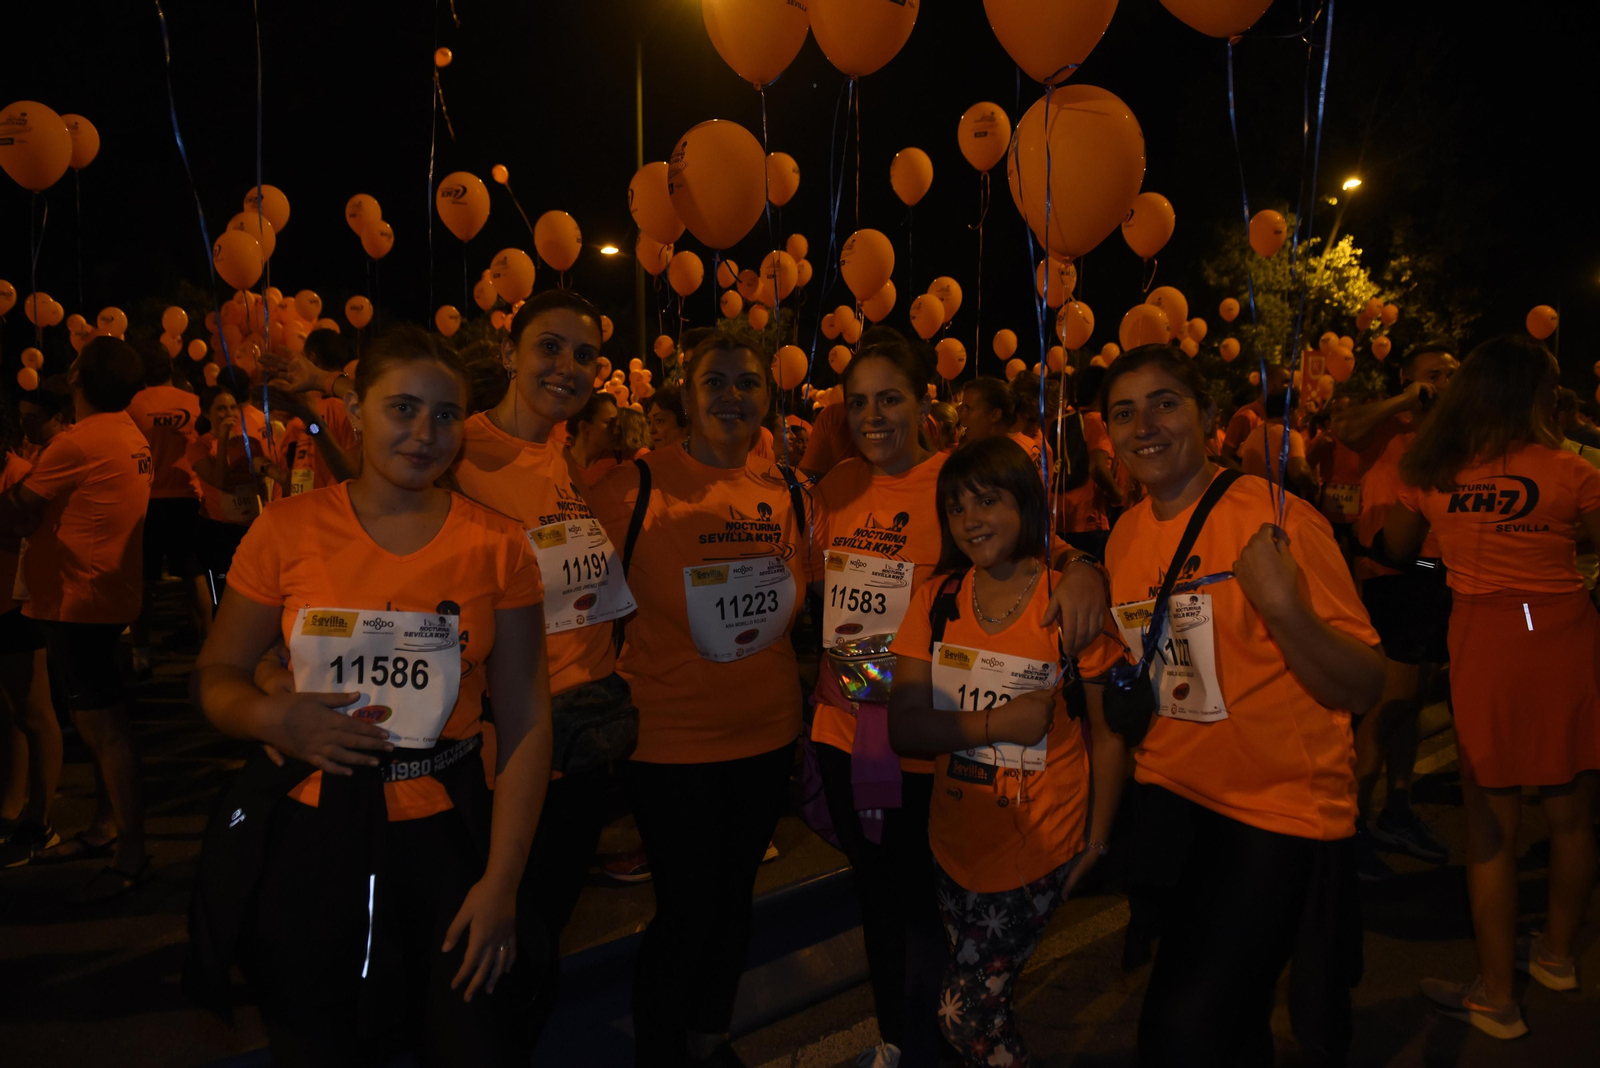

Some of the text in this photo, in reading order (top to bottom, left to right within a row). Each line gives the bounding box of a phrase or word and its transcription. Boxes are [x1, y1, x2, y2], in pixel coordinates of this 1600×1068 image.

[726, 521, 781, 532] NOCTURNA
[1496, 524, 1549, 532] SEVILLA
[699, 533, 754, 544] SEVILLA
[832, 537, 871, 551] SEVILLA
[854, 528, 907, 545] NOCTURNA
[563, 551, 609, 585] 11191
[716, 590, 779, 620] 11223
[831, 585, 886, 614] 11583
[330, 656, 429, 690] 11586
